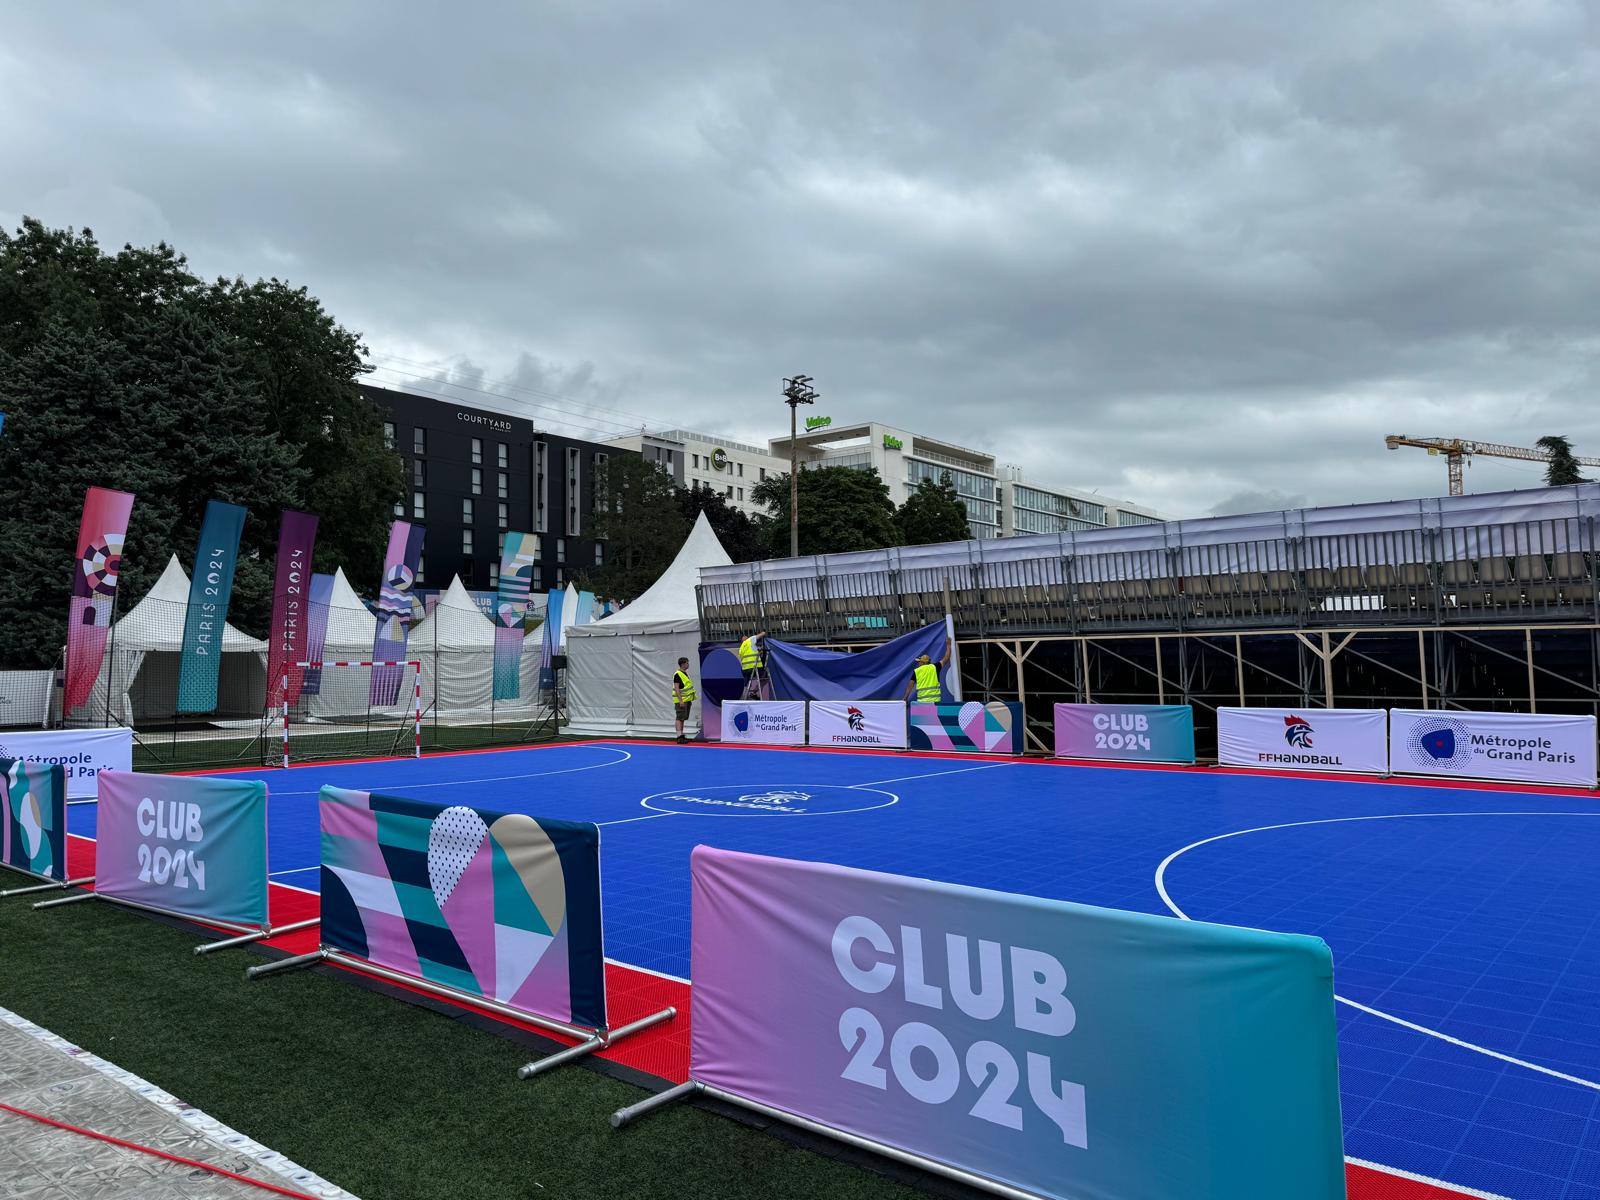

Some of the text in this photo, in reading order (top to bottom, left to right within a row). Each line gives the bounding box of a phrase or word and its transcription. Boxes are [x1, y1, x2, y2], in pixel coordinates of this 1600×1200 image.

[457, 412, 512, 430] COURTYARD
[205, 549, 225, 596] 2024
[287, 549, 303, 595] 2024
[754, 714, 788, 724] Métropole
[761, 723, 780, 731] Grand
[1093, 713, 1149, 731] CLUB
[1094, 732, 1151, 750] 2024
[1470, 734, 1552, 750] Métropole
[1486, 748, 1533, 761] Grand
[1538, 751, 1576, 764] Paris
[136, 797, 204, 842] CLUB
[137, 843, 206, 891] 2024
[831, 915, 1077, 1037] CLUB
[838, 1007, 1088, 1150] 2024
